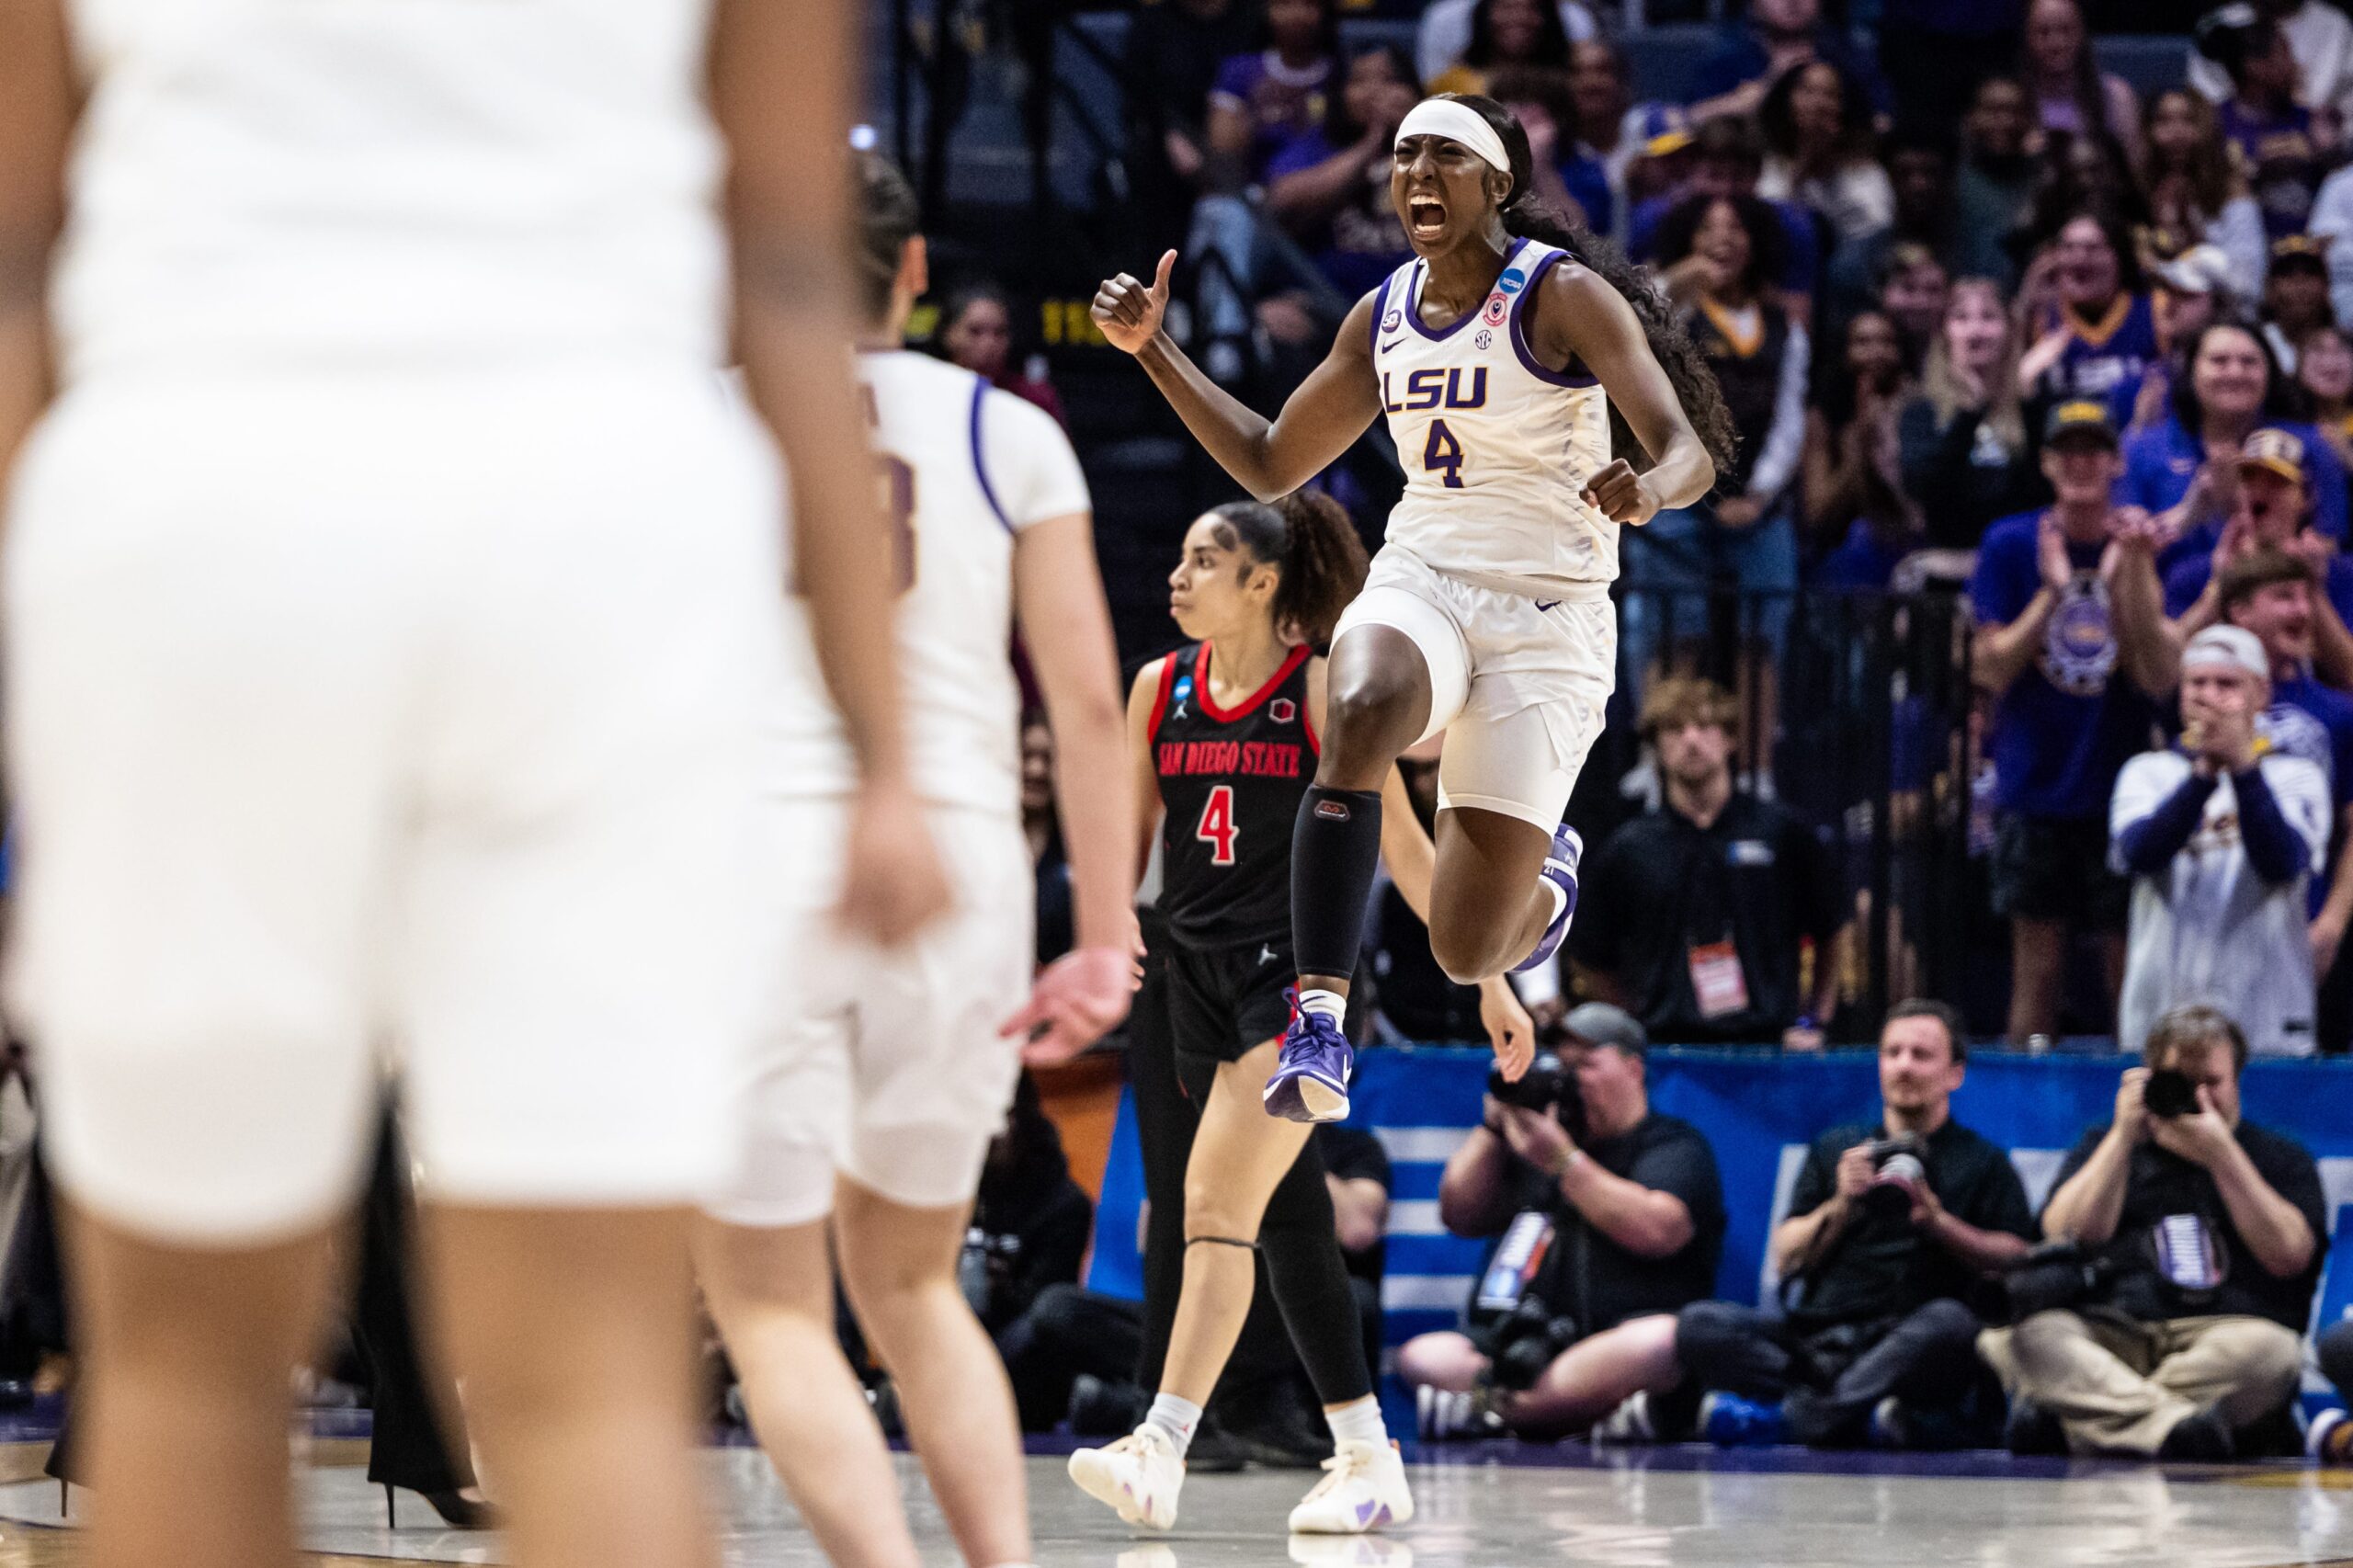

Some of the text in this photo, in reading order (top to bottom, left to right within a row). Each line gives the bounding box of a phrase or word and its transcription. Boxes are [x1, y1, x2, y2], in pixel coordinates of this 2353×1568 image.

[1476, 330, 1492, 349] SEC
[1381, 366, 1489, 415] LSU
[1424, 417, 1465, 489] 4
[1158, 740, 1302, 778] SAN DIEGO STATE
[1197, 785, 1240, 866] 4
